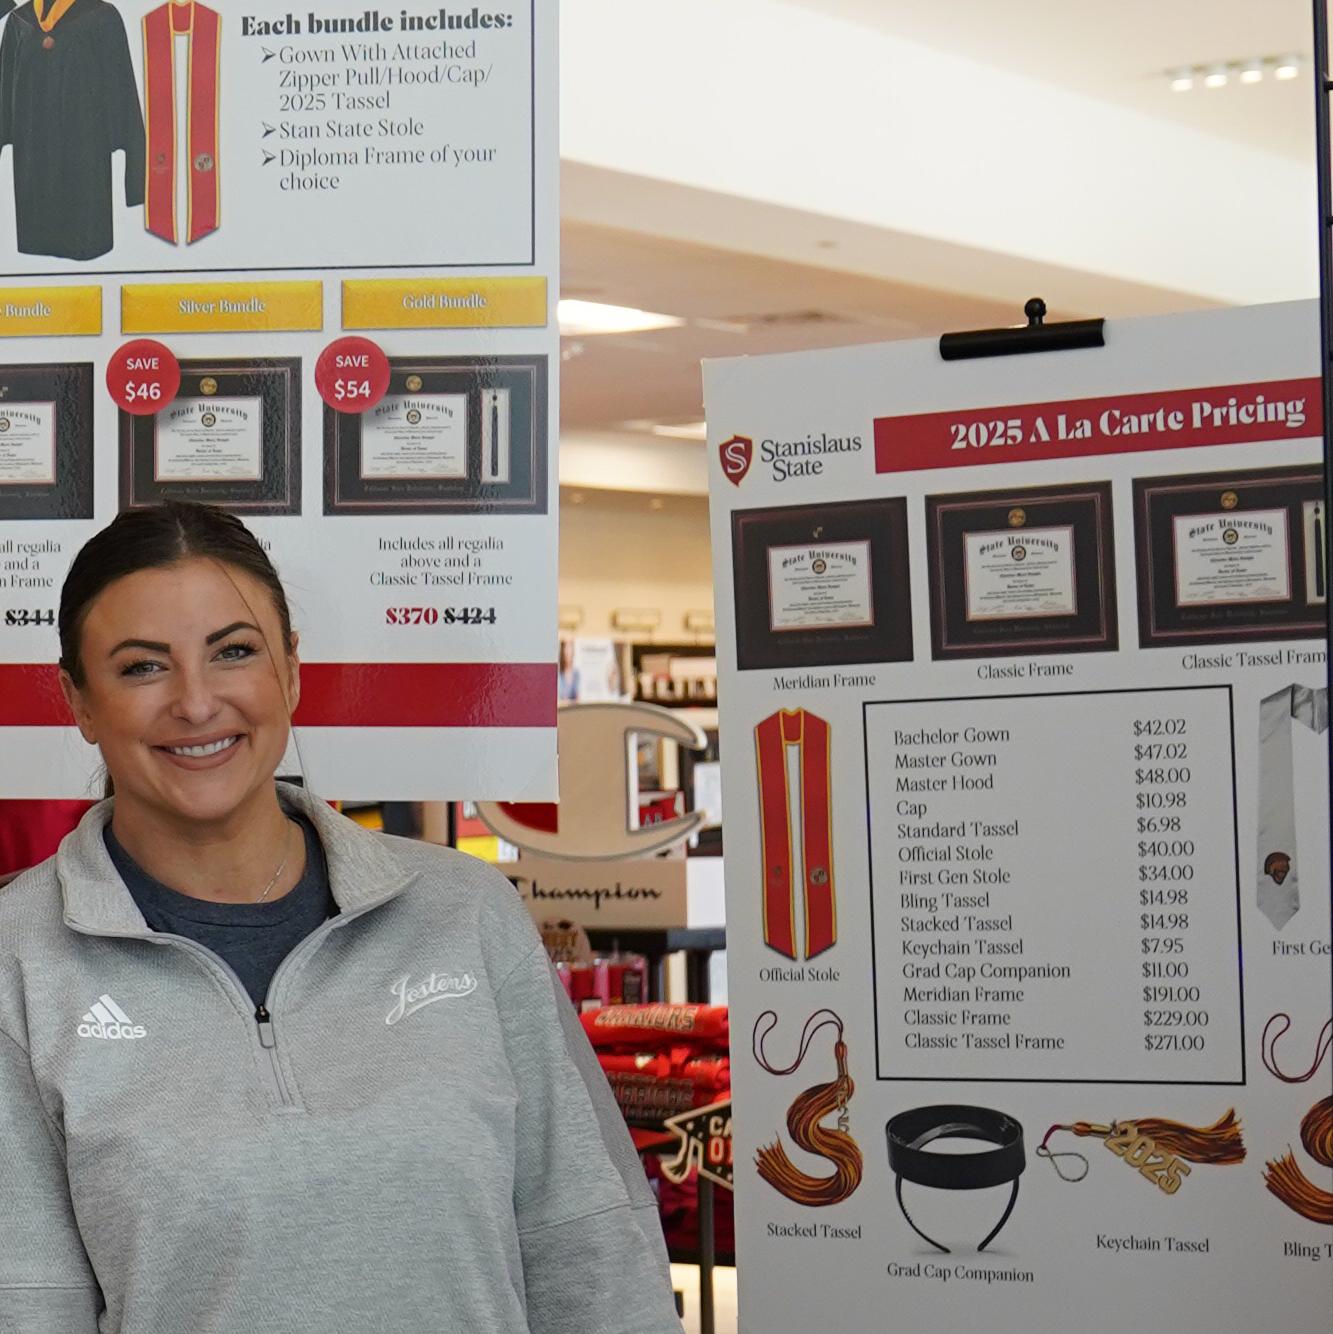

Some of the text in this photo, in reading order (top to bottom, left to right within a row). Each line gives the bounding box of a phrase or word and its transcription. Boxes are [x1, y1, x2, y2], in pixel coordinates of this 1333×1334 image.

[242, 8, 513, 36] Each bundle includes:
[6, 302, 51, 318] Bundle
[178, 298, 266, 314] Silver Bundle
[403, 294, 486, 309] Gold Bundle
[126, 358, 158, 370] SAVE
[336, 355, 369, 368] SAVE
[125, 382, 160, 401] $46
[334, 380, 371, 400] $54
[950, 396, 1305, 450] 2025 A La Carte Pricing
[760, 432, 862, 463] Stanislaus
[772, 457, 823, 483] State
[5, 609, 54, 627] $344
[386, 607, 496, 625] $370 $424
[1182, 650, 1326, 669] Classic Tassel Fram
[977, 662, 1074, 681] Classic Frame
[773, 673, 876, 691] Meridian Frame
[894, 719, 1186, 746] Bachelor Gown $42.02
[895, 743, 1187, 769] Master Gown $47.02
[896, 767, 1190, 792] Master Hood $48.00
[897, 792, 1186, 818] Cap $10.98
[898, 816, 1180, 838] Standard Tassel $6.98
[899, 841, 1194, 862] Official Stole $40.00
[900, 865, 1194, 886] First Gen Stole $34.00
[901, 890, 1187, 912] Bling Tassel $14.98
[901, 914, 1189, 932] Stacked Tassel $14.98
[903, 938, 1183, 958] Keychain Tassel $7.95
[1273, 940, 1331, 955] First Ge
[759, 966, 841, 983] Official Stole
[903, 962, 1188, 982] Grad Cap Companion $11.00
[385, 971, 478, 1026] Jostens
[904, 986, 1199, 1002] Meridian Frame $191.00
[904, 1010, 1208, 1027] Classic Frame $229.00
[76, 1022, 147, 1040] adidas
[905, 1033, 1204, 1051] Classic Tassel Frame $271.00
[1104, 1121, 1191, 1195] 2025
[767, 1222, 862, 1240] Stacked Tassel
[1096, 1234, 1209, 1253] Keychain Tassel
[1284, 1242, 1321, 1261] Bling
[887, 1263, 1034, 1283] Grad Cap Companion
